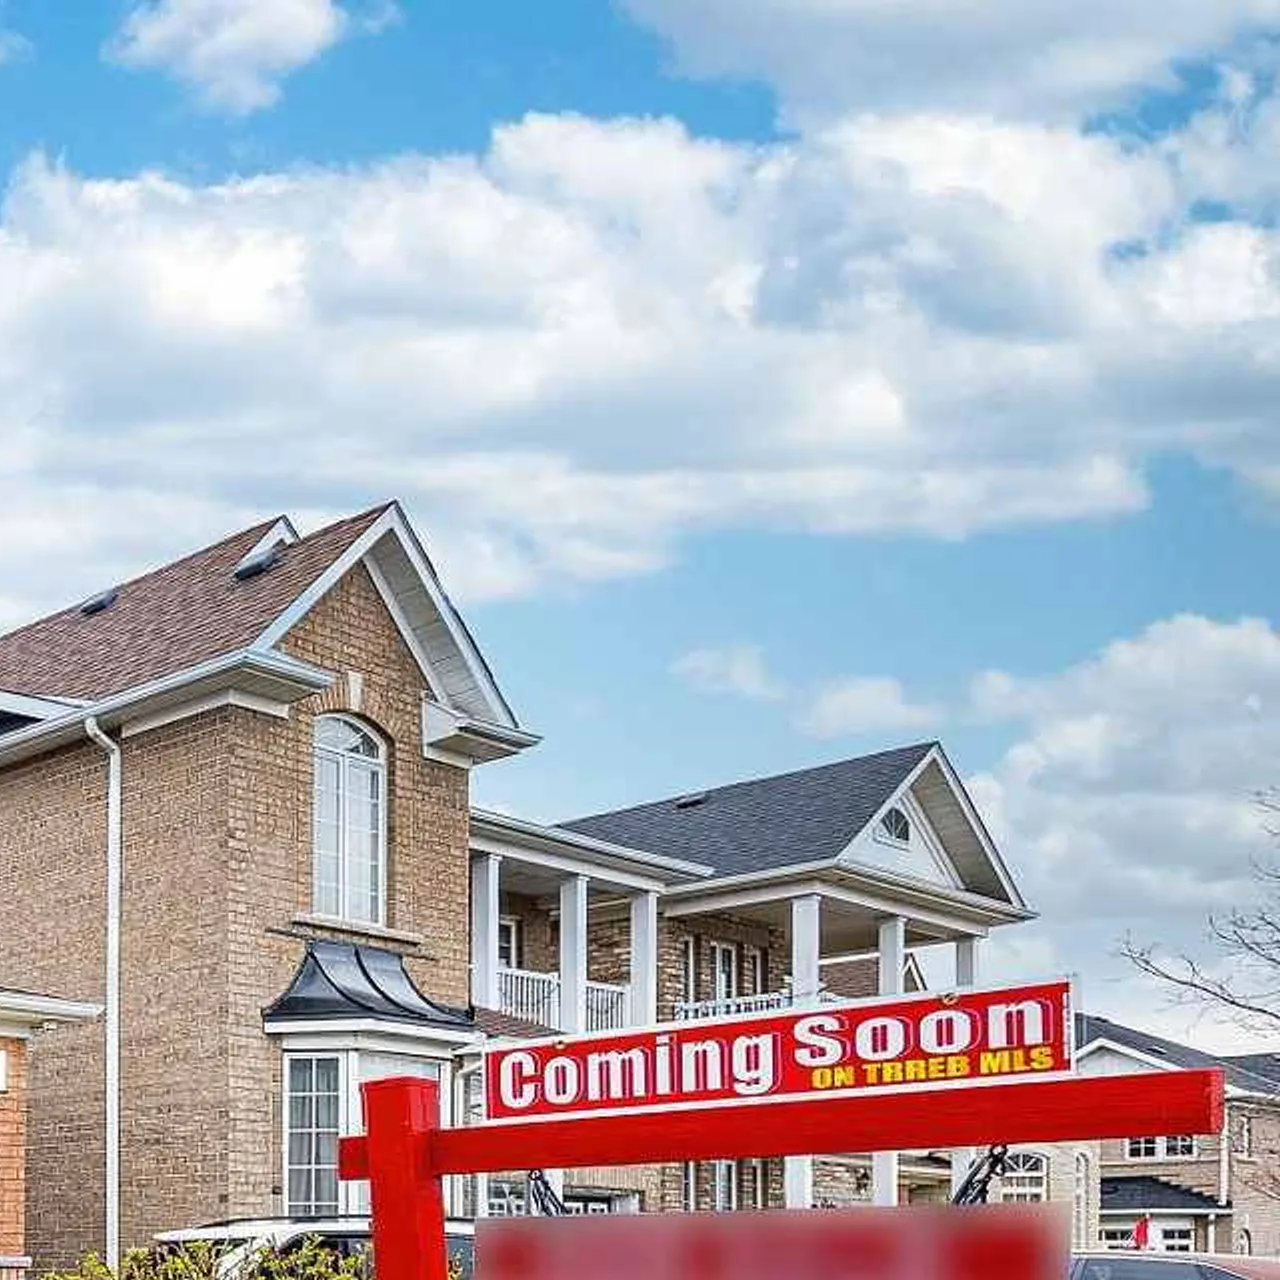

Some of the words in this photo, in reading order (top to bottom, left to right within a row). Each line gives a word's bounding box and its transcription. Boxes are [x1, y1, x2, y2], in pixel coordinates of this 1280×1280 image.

[498, 1030, 782, 1108] Coming
[793, 998, 1053, 1068] Soon
[811, 1066, 855, 1089] ON
[980, 1046, 1055, 1075] MLS
